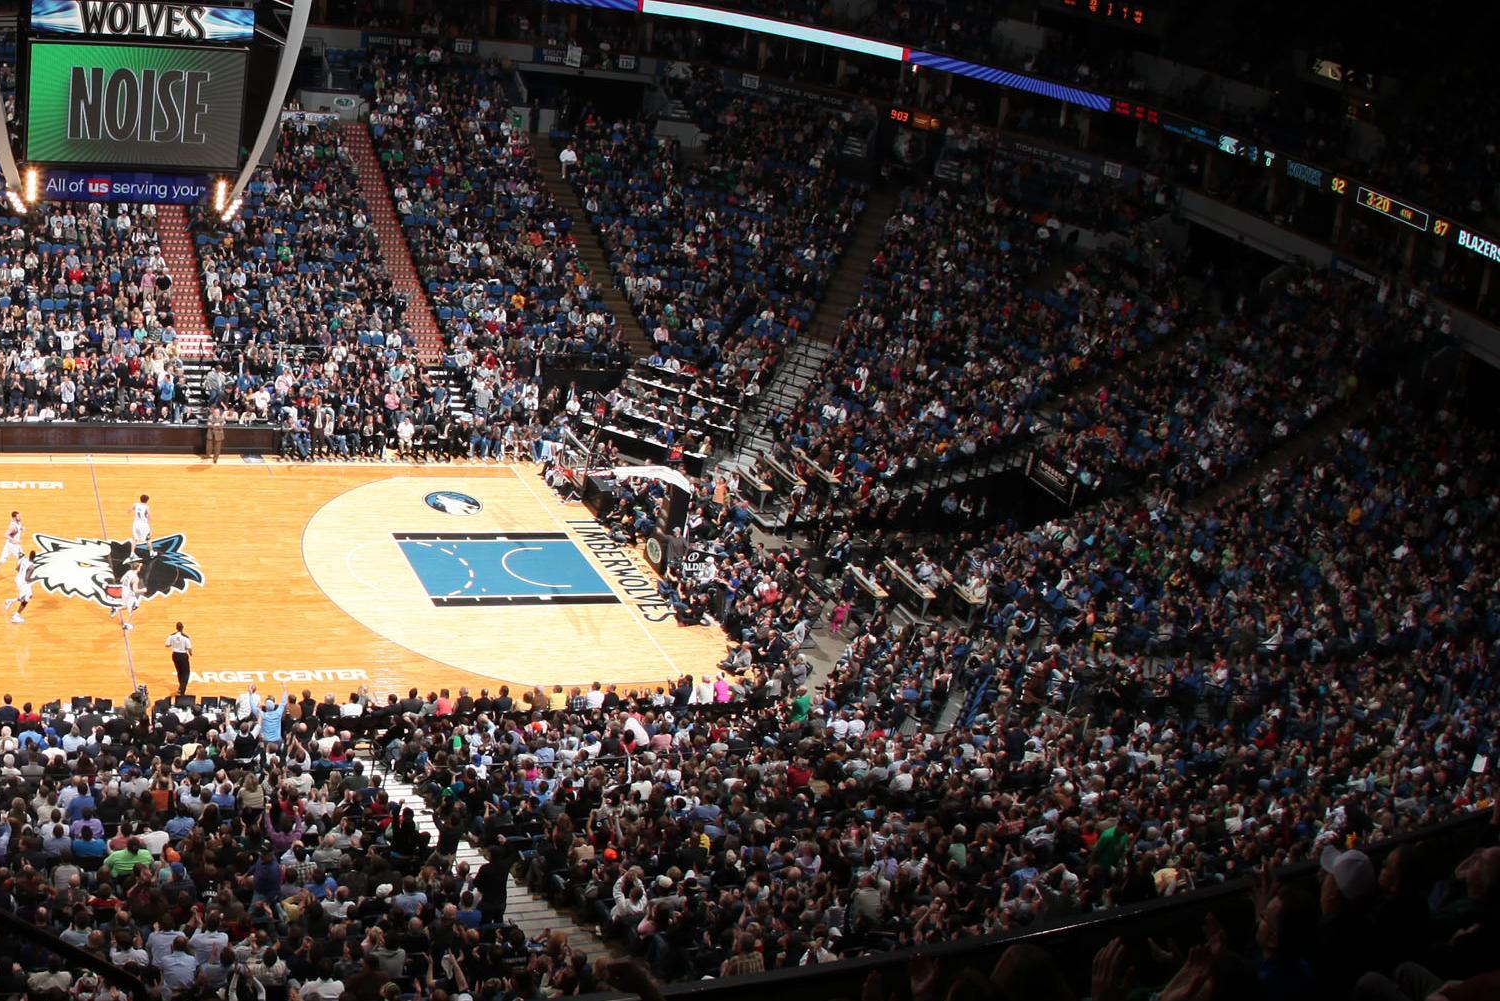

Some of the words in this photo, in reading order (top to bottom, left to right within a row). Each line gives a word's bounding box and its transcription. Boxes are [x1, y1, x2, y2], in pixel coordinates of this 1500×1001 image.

[78, 0, 205, 39] WOLVES
[67, 66, 210, 144] NOISE
[45, 178, 66, 193] All
[69, 179, 84, 193] of
[88, 183, 109, 193] us
[112, 181, 168, 198] serving
[1331, 177, 1346, 194] 92
[1366, 192, 1390, 213] 3:20
[1433, 219, 1449, 236] 87
[1457, 230, 1500, 264] BLAZERS
[272, 669, 369, 682] CENTER
